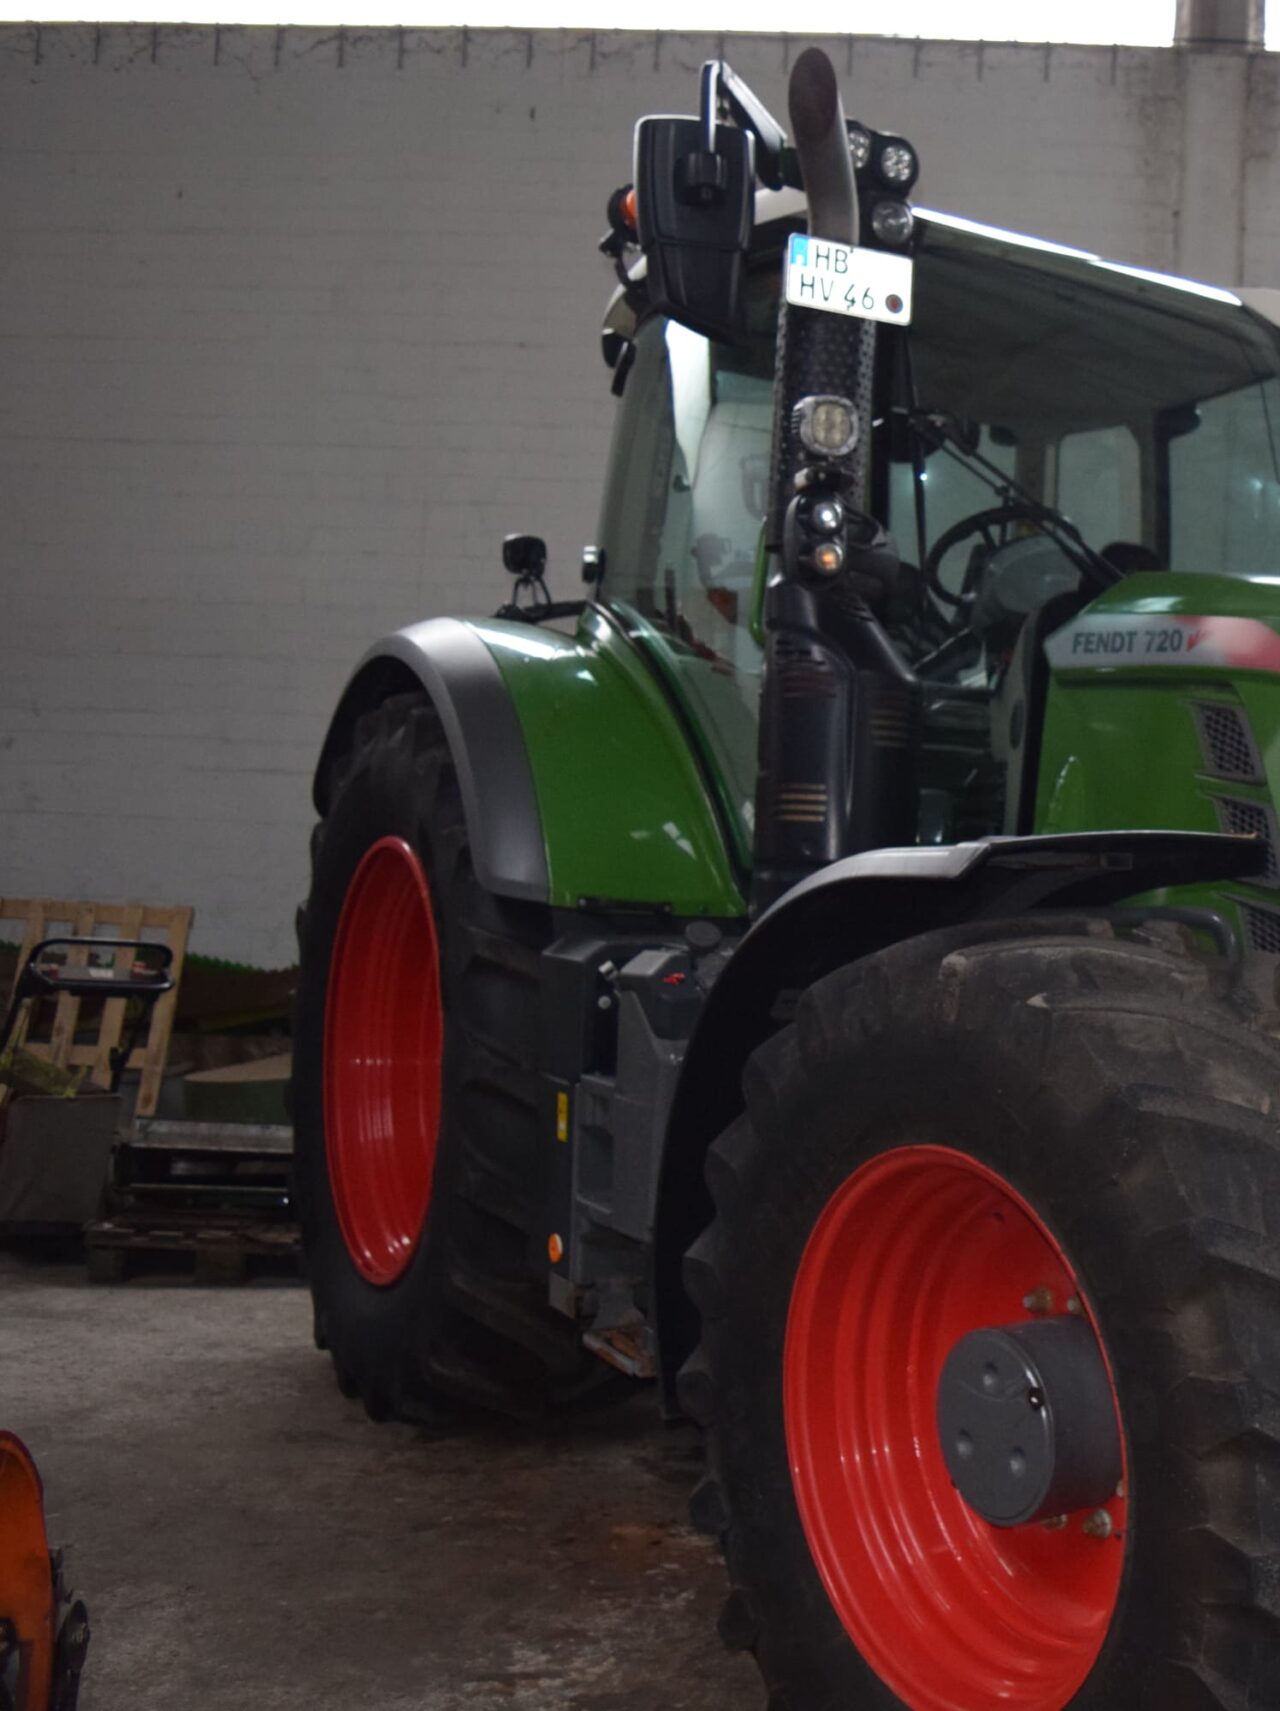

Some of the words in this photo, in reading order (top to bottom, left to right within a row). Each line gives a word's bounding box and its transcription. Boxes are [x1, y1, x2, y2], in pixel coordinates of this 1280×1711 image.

[815, 245, 849, 274] HB
[800, 273, 834, 302] HV
[843, 283, 875, 311] 46
[1071, 631, 1138, 655] FENDT
[1144, 630, 1184, 652] 720
